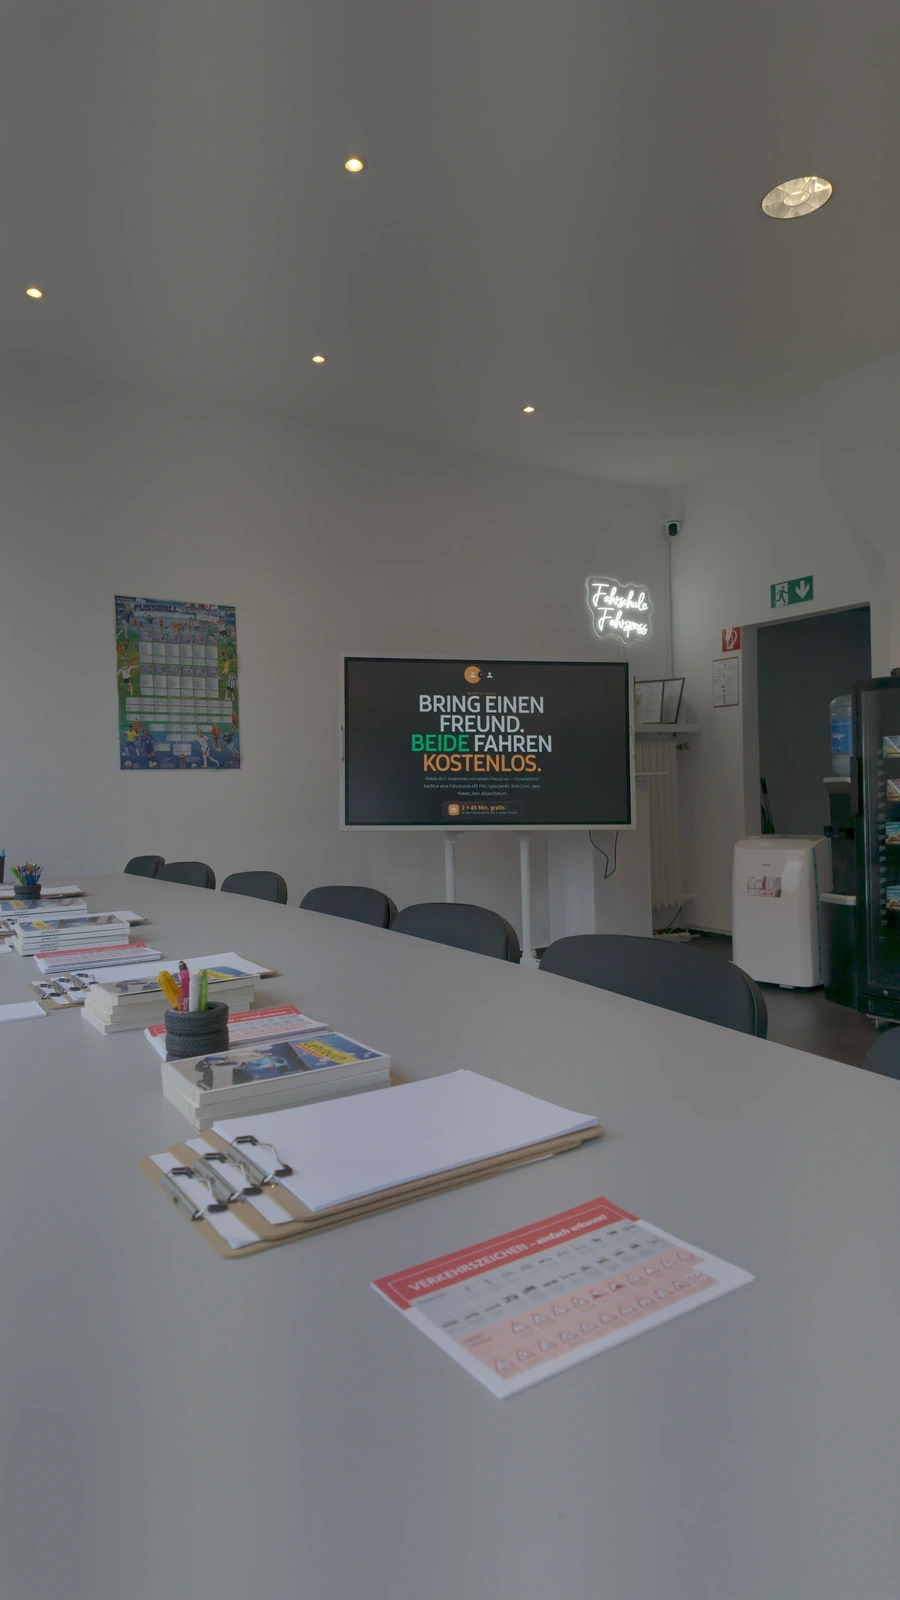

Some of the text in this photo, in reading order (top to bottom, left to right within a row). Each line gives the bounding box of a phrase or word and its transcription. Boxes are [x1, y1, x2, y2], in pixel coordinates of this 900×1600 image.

[591, 583, 649, 611] Fahrschule
[133, 604, 179, 613] FUSSBALL
[597, 607, 649, 638] Fahrspass
[419, 694, 544, 714] BRING EINEN
[440, 714, 525, 733] FREUND.
[411, 733, 552, 753] BEIDE FAHREN
[423, 754, 542, 772] KOSTENLOS.
[490, 804, 505, 812] gratis
[302, 1040, 348, 1062] Lehrbuch
[407, 1242, 529, 1292] VERKEHRSZEICHEN
[537, 1227, 571, 1246] einfach
[570, 1213, 608, 1233] erkannt!
